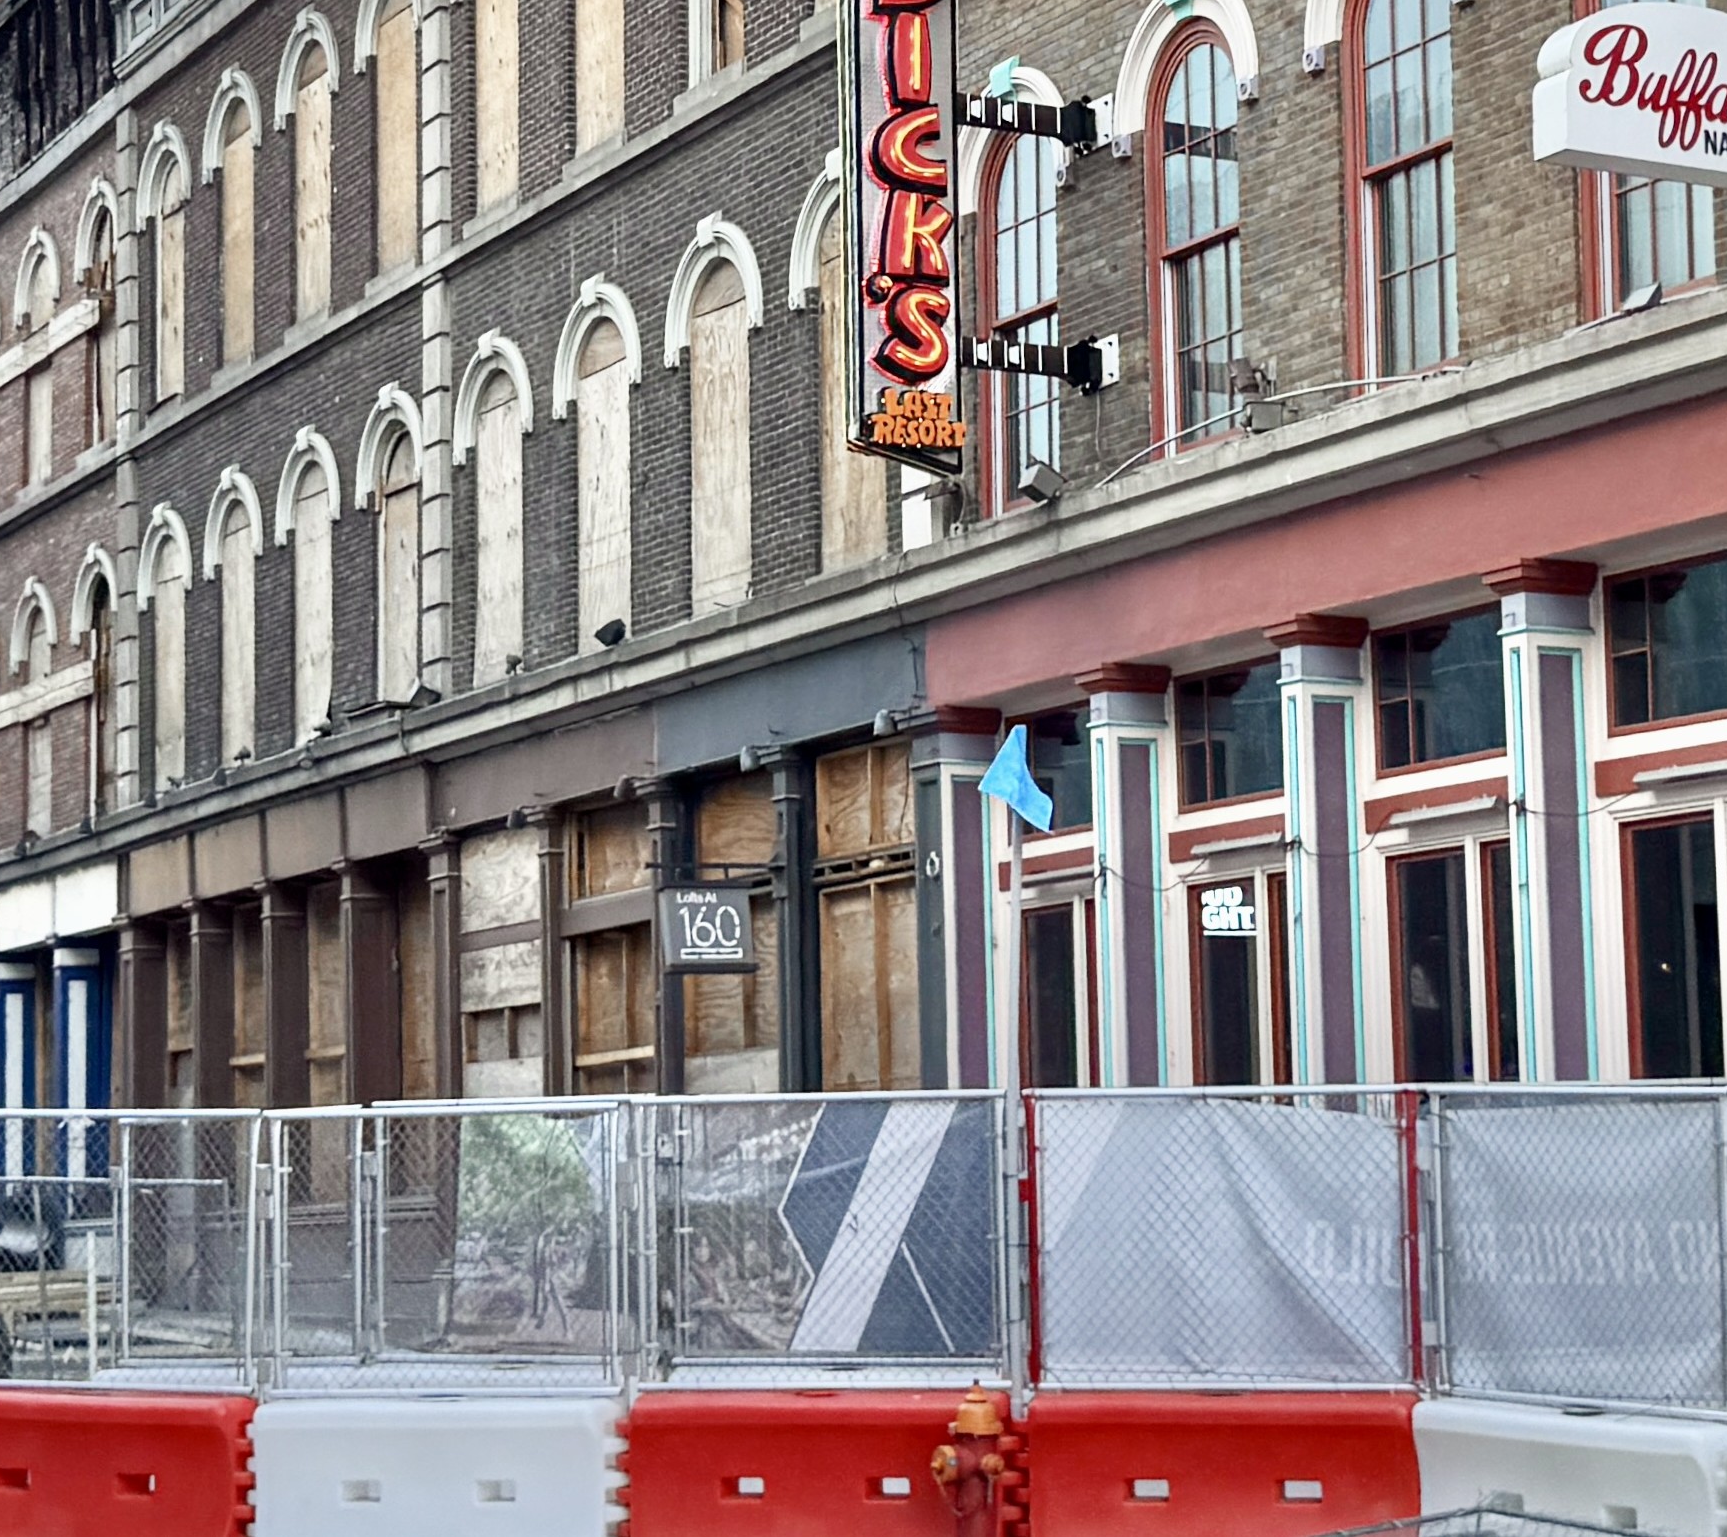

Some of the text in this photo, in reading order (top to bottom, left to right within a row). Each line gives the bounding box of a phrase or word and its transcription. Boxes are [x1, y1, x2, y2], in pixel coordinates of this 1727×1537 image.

[882, 388, 953, 419] LAST
[870, 412, 967, 447] RESORT
[678, 905, 741, 948] 160
